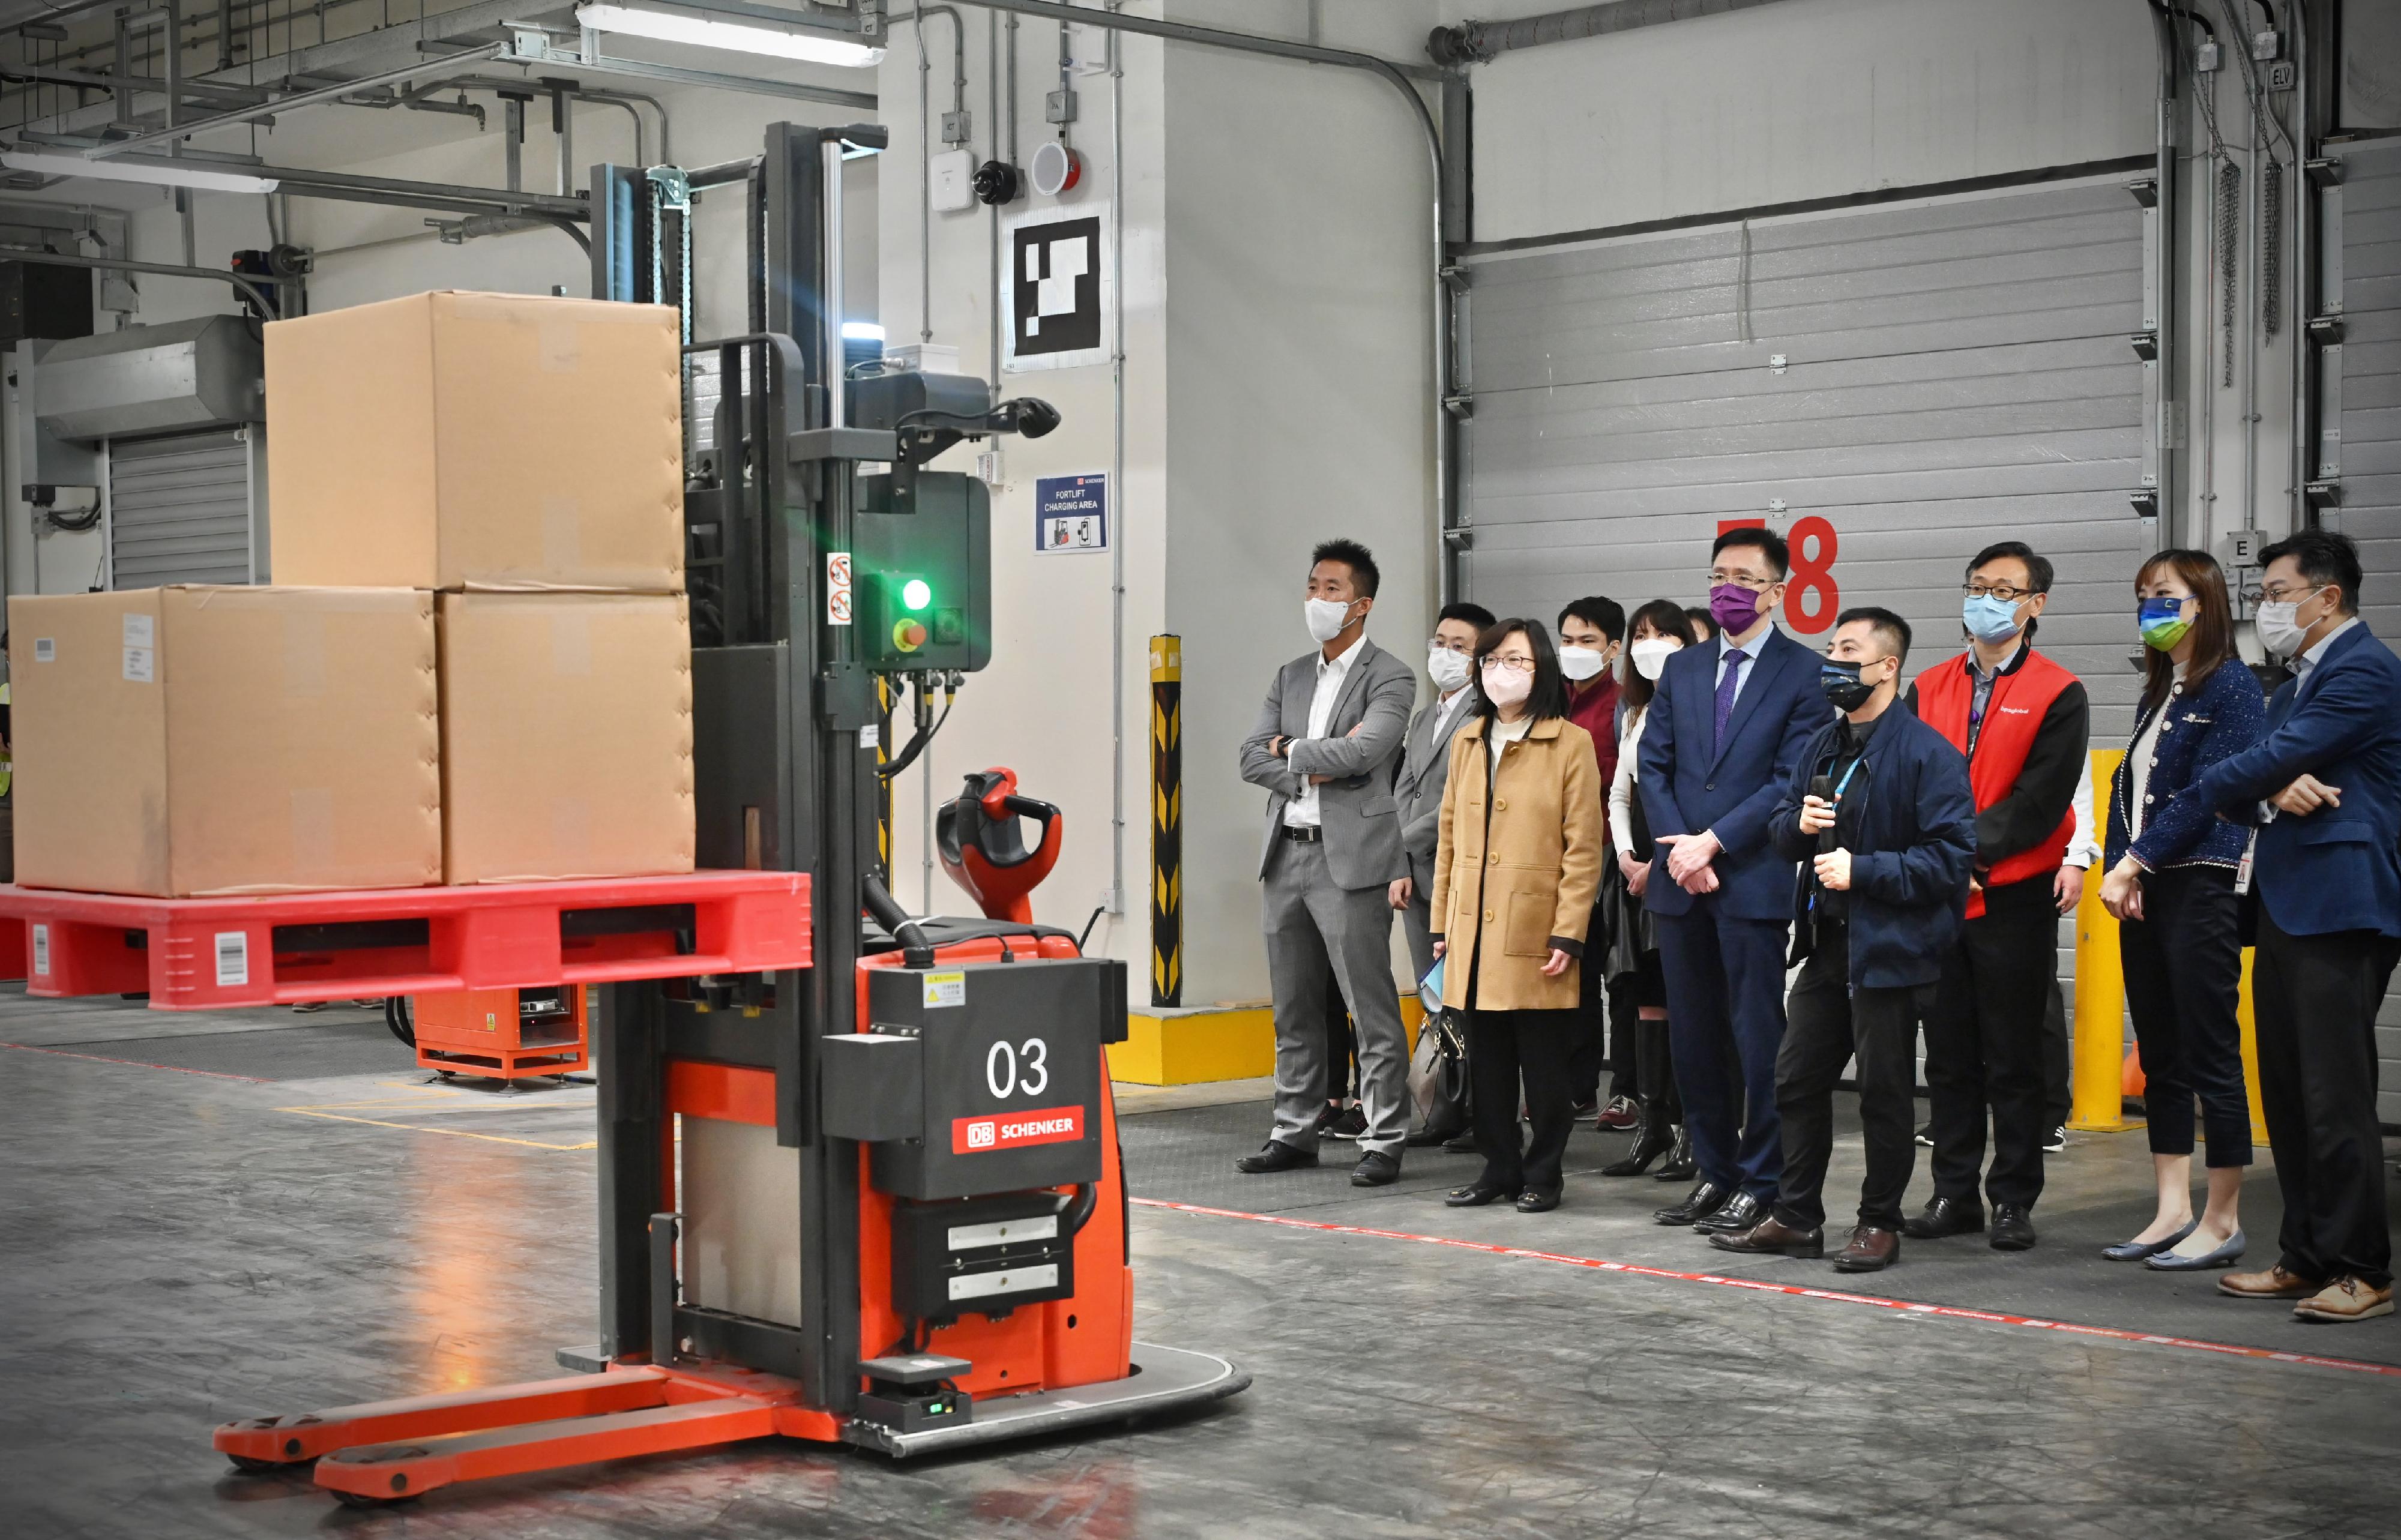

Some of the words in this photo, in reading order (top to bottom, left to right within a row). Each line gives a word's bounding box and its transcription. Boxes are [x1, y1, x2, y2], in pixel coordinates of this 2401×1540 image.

[2274, 68, 2290, 85] ELV
[1056, 489, 1085, 499] FORTLIFT
[1044, 502, 1077, 512] CHARGING
[1079, 501, 1098, 509] AREA
[2237, 541, 2247, 555] E
[987, 1038, 1048, 1098] 03
[970, 1125, 992, 1145] DB
[1001, 1118, 1074, 1139] SCHENKER
